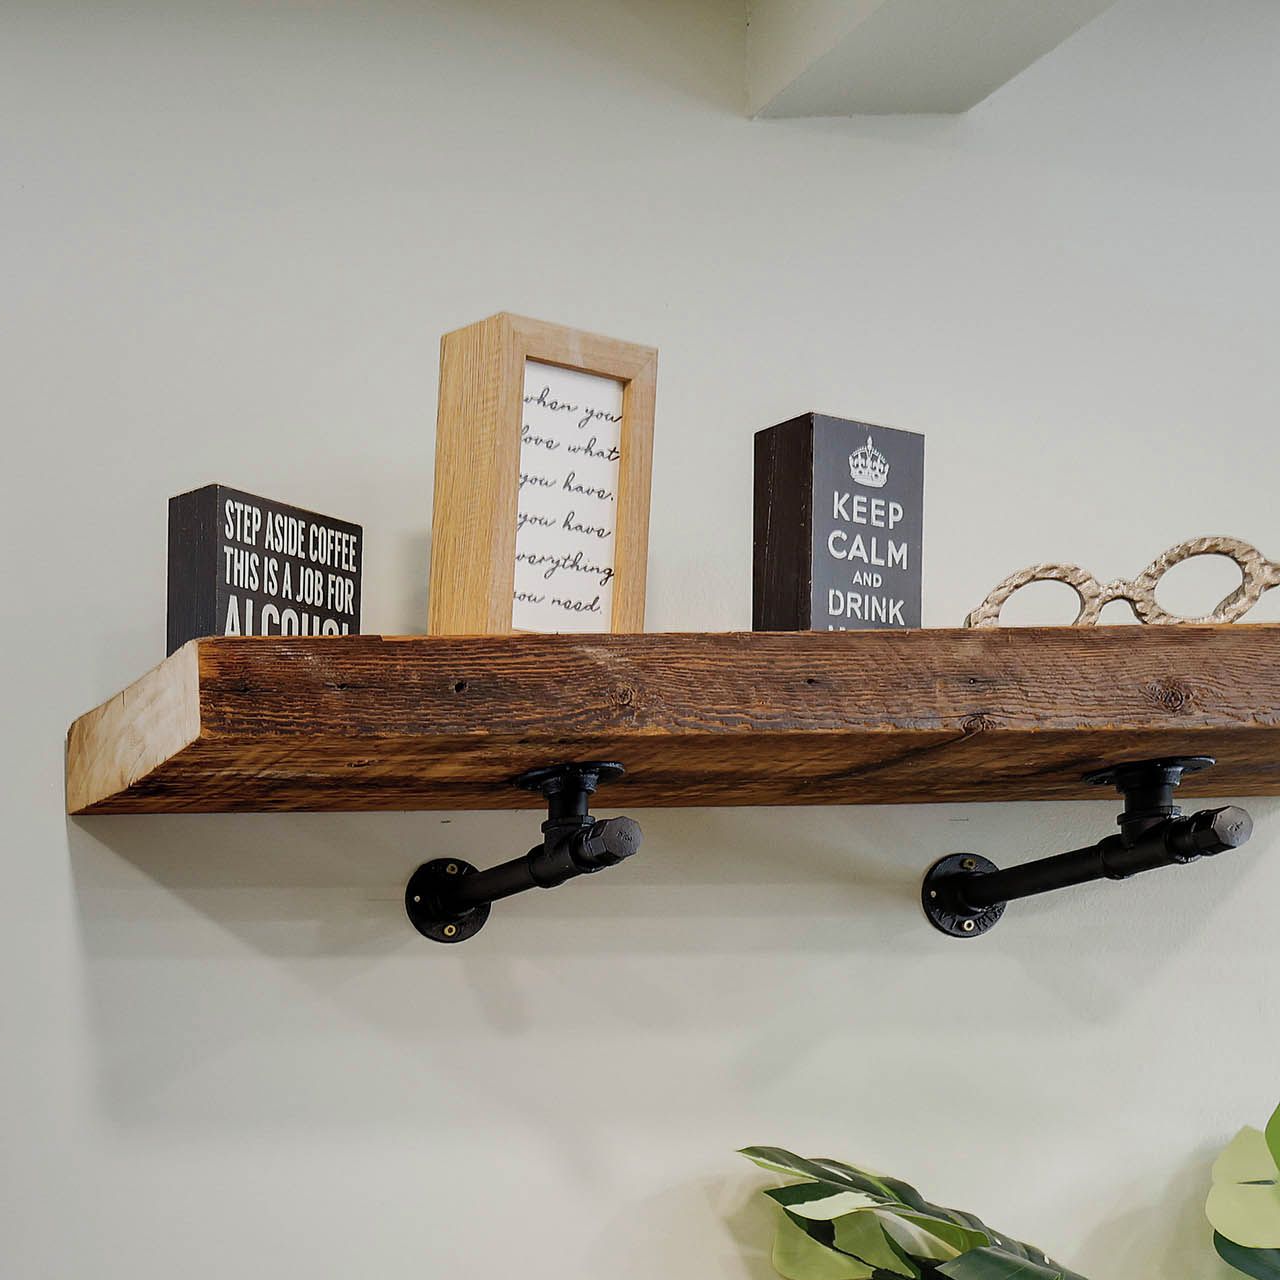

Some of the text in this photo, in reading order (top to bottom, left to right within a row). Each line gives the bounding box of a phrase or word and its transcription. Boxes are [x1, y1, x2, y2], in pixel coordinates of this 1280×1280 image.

[578, 407, 622, 428] you
[568, 437, 621, 461] what
[833, 490, 904, 530] KEEP
[224, 499, 357, 573] STEP ASIDE COFFEE
[827, 529, 908, 570] CALM
[223, 545, 354, 615] THIS IS A JOB FOR
[515, 551, 615, 586] verything
[852, 570, 882, 588] AND
[224, 594, 349, 637] ALCO
[513, 591, 544, 603] ou
[828, 588, 905, 626] DRINK
